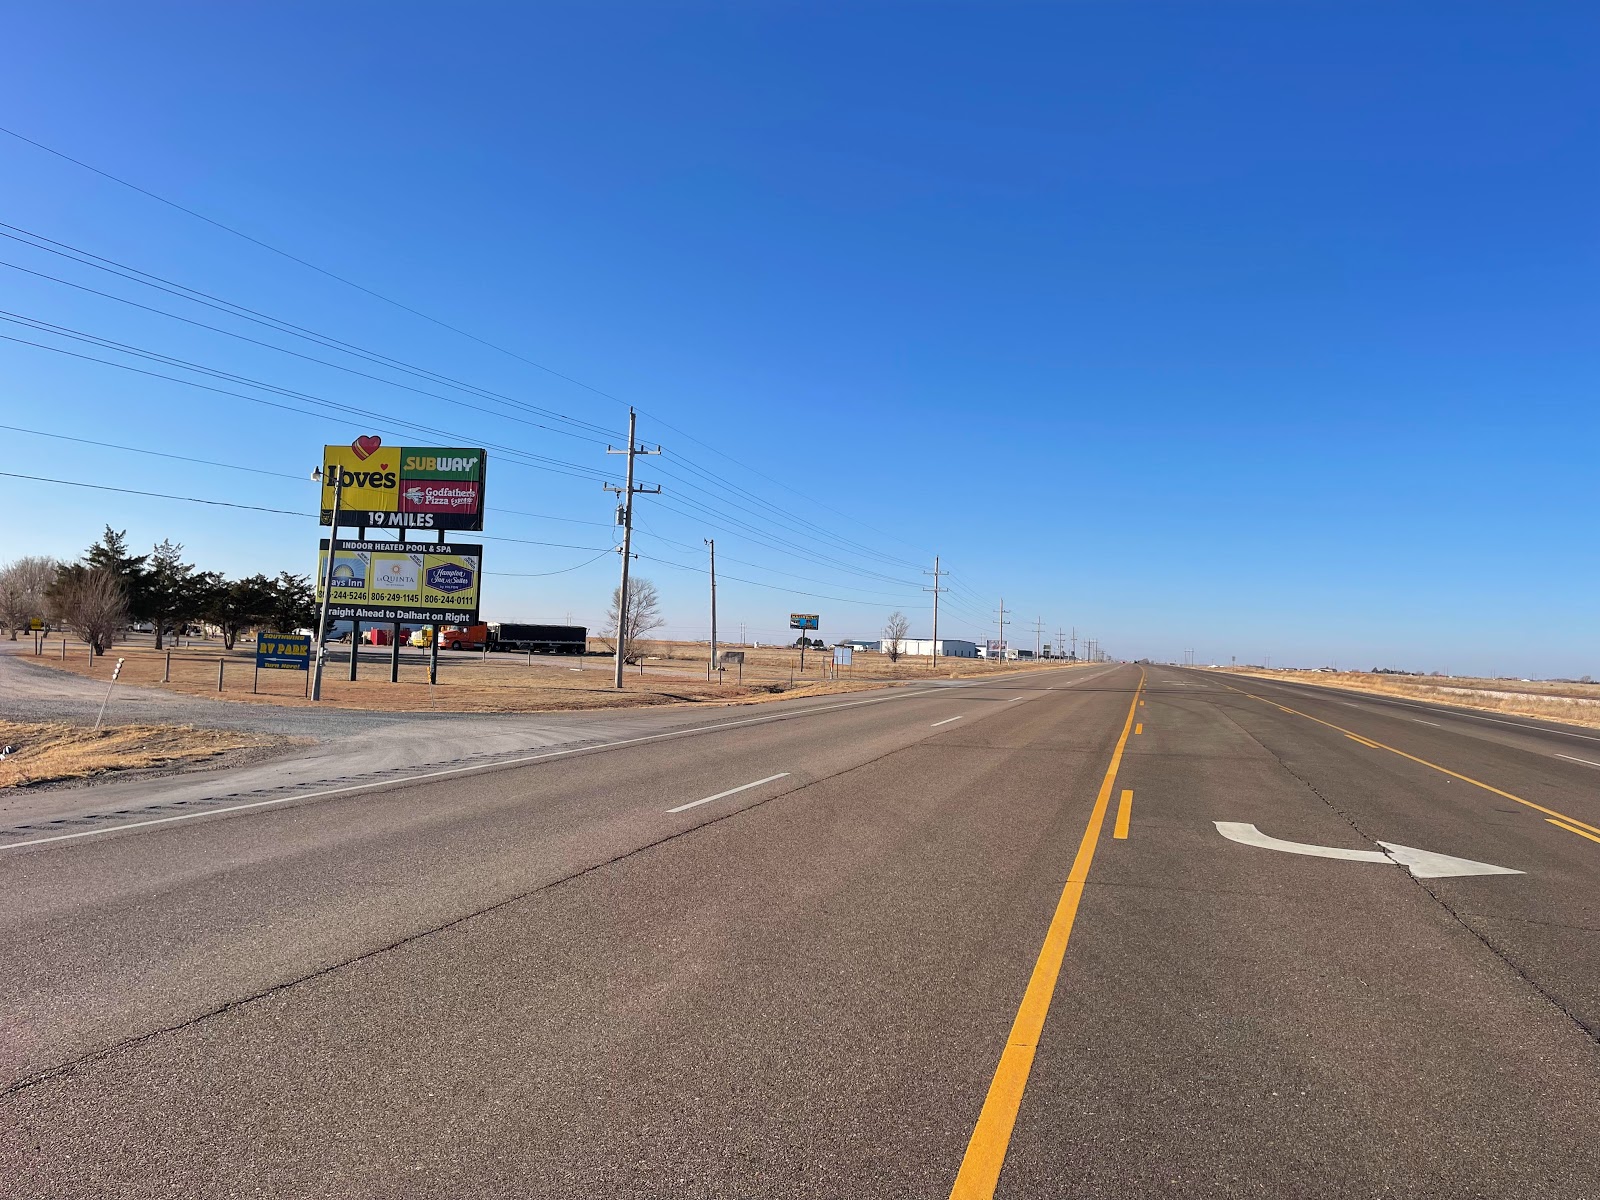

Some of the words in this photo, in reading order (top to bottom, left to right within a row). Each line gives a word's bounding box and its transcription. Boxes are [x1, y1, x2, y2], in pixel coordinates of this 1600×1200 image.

[403, 457, 478, 472] SUBWAY
[426, 487, 475, 498] Godfather's
[425, 496, 449, 504] Pizza
[368, 512, 384, 525] 19
[388, 512, 434, 527] MILES
[342, 542, 373, 550] INDOOR
[374, 542, 404, 551] HEATED
[406, 544, 428, 552] POOL
[436, 545, 452, 553] SPA
[433, 568, 466, 577] Hampton
[318, 590, 366, 600] 8-244-5246
[320, 606, 354, 618] Sraight
[356, 608, 384, 618] Ahead
[397, 611, 430, 620] Dalhart
[445, 613, 469, 622] Right
[259, 642, 275, 654] RV
[277, 644, 308, 656] PARK
